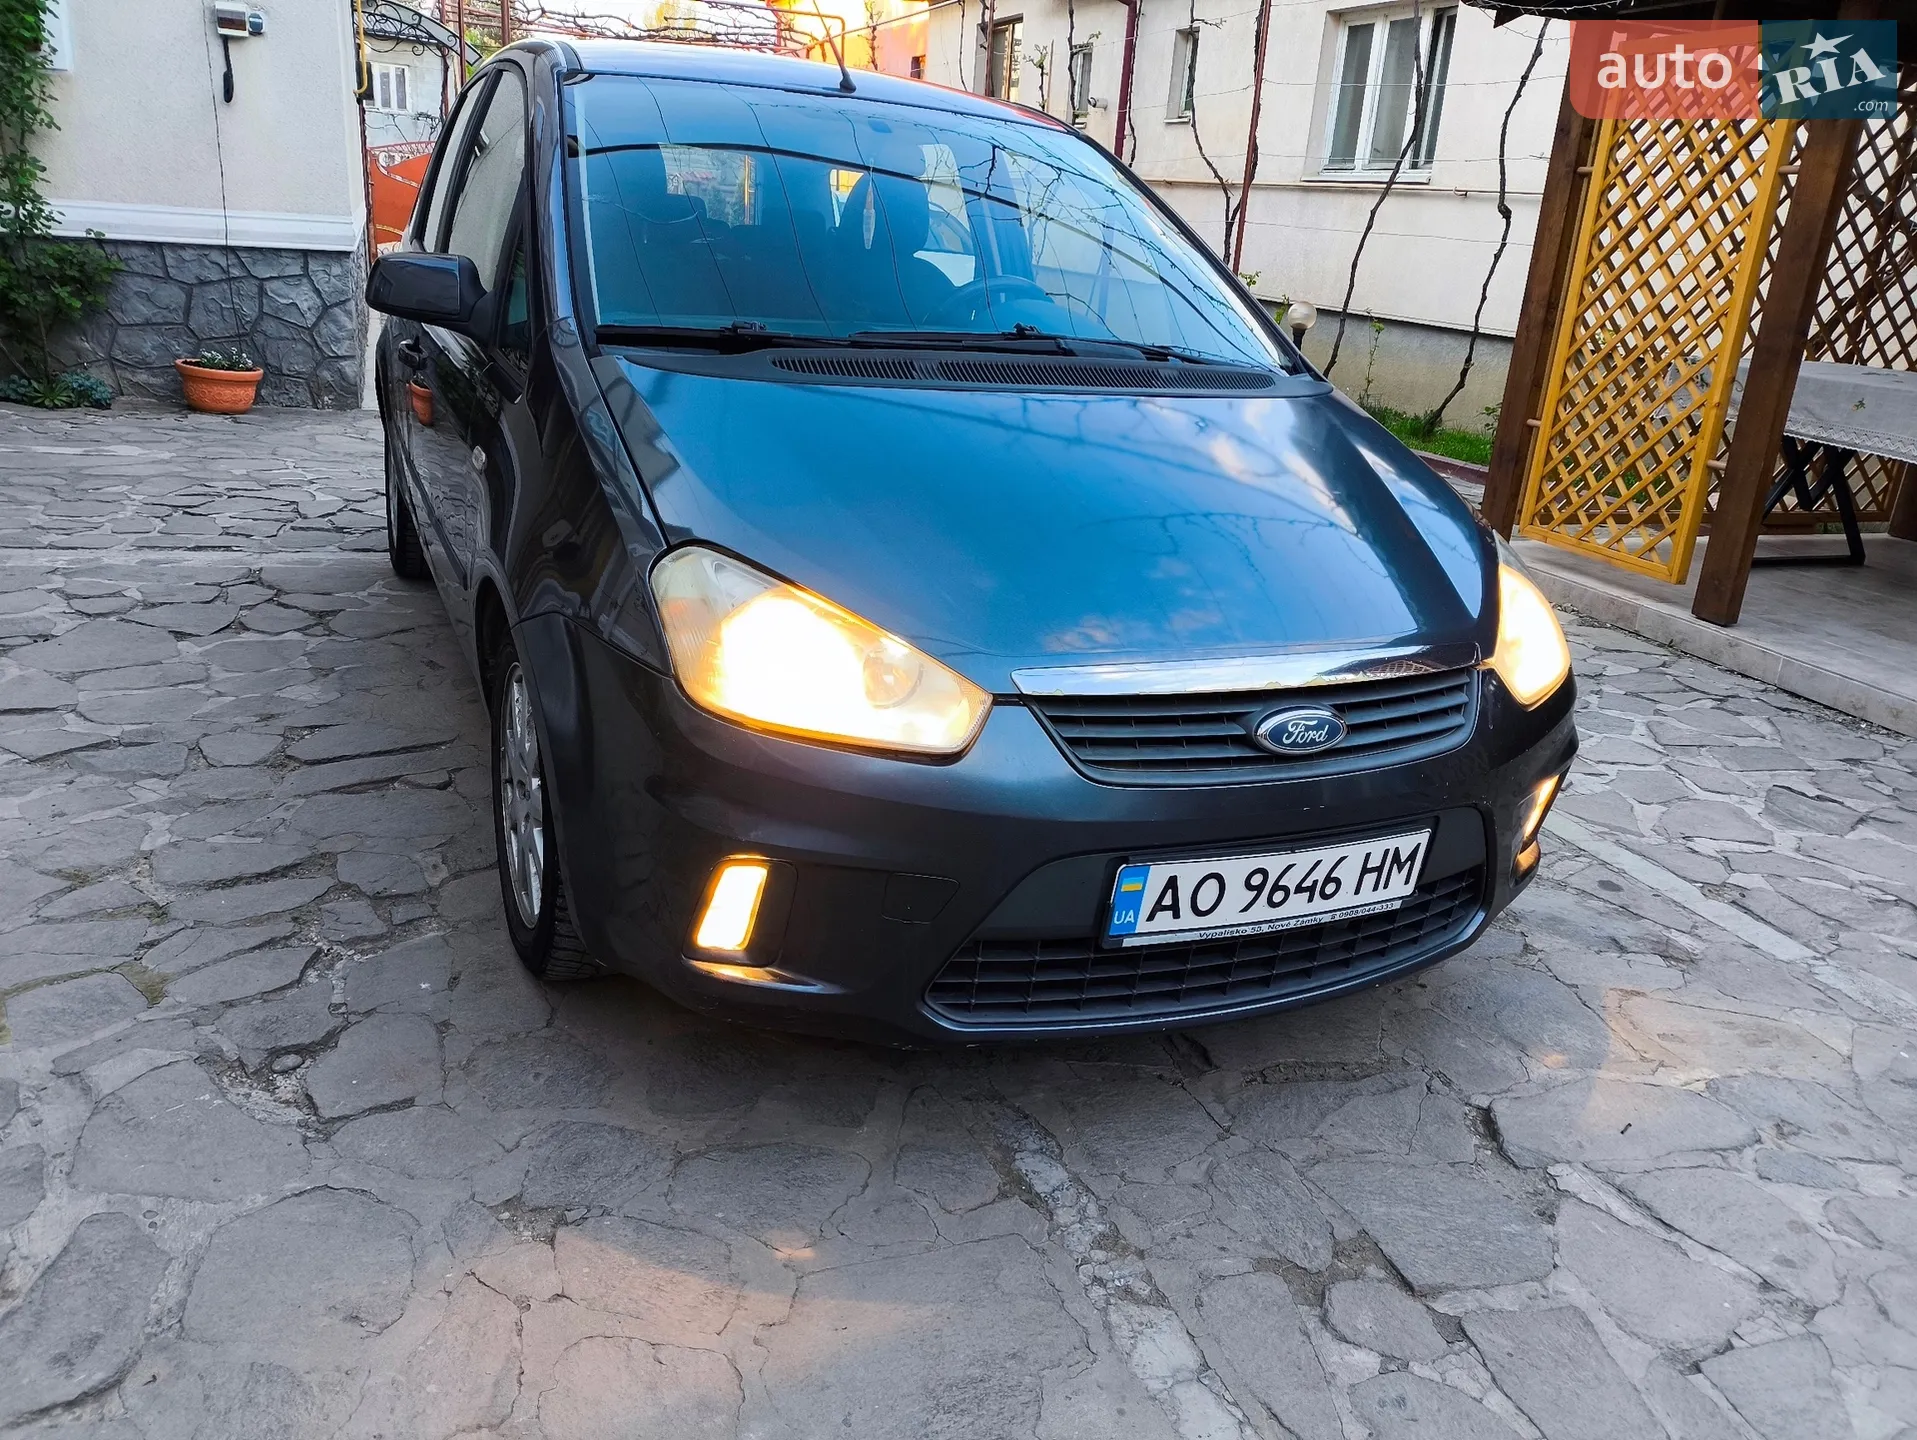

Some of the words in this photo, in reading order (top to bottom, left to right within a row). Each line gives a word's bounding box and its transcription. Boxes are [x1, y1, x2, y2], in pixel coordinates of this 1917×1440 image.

[1282, 720, 1329, 744] Ford
[1146, 873, 1226, 922] AO
[1239, 855, 1348, 913] 9646
[1353, 842, 1421, 895] HM
[1114, 911, 1135, 924] UA
